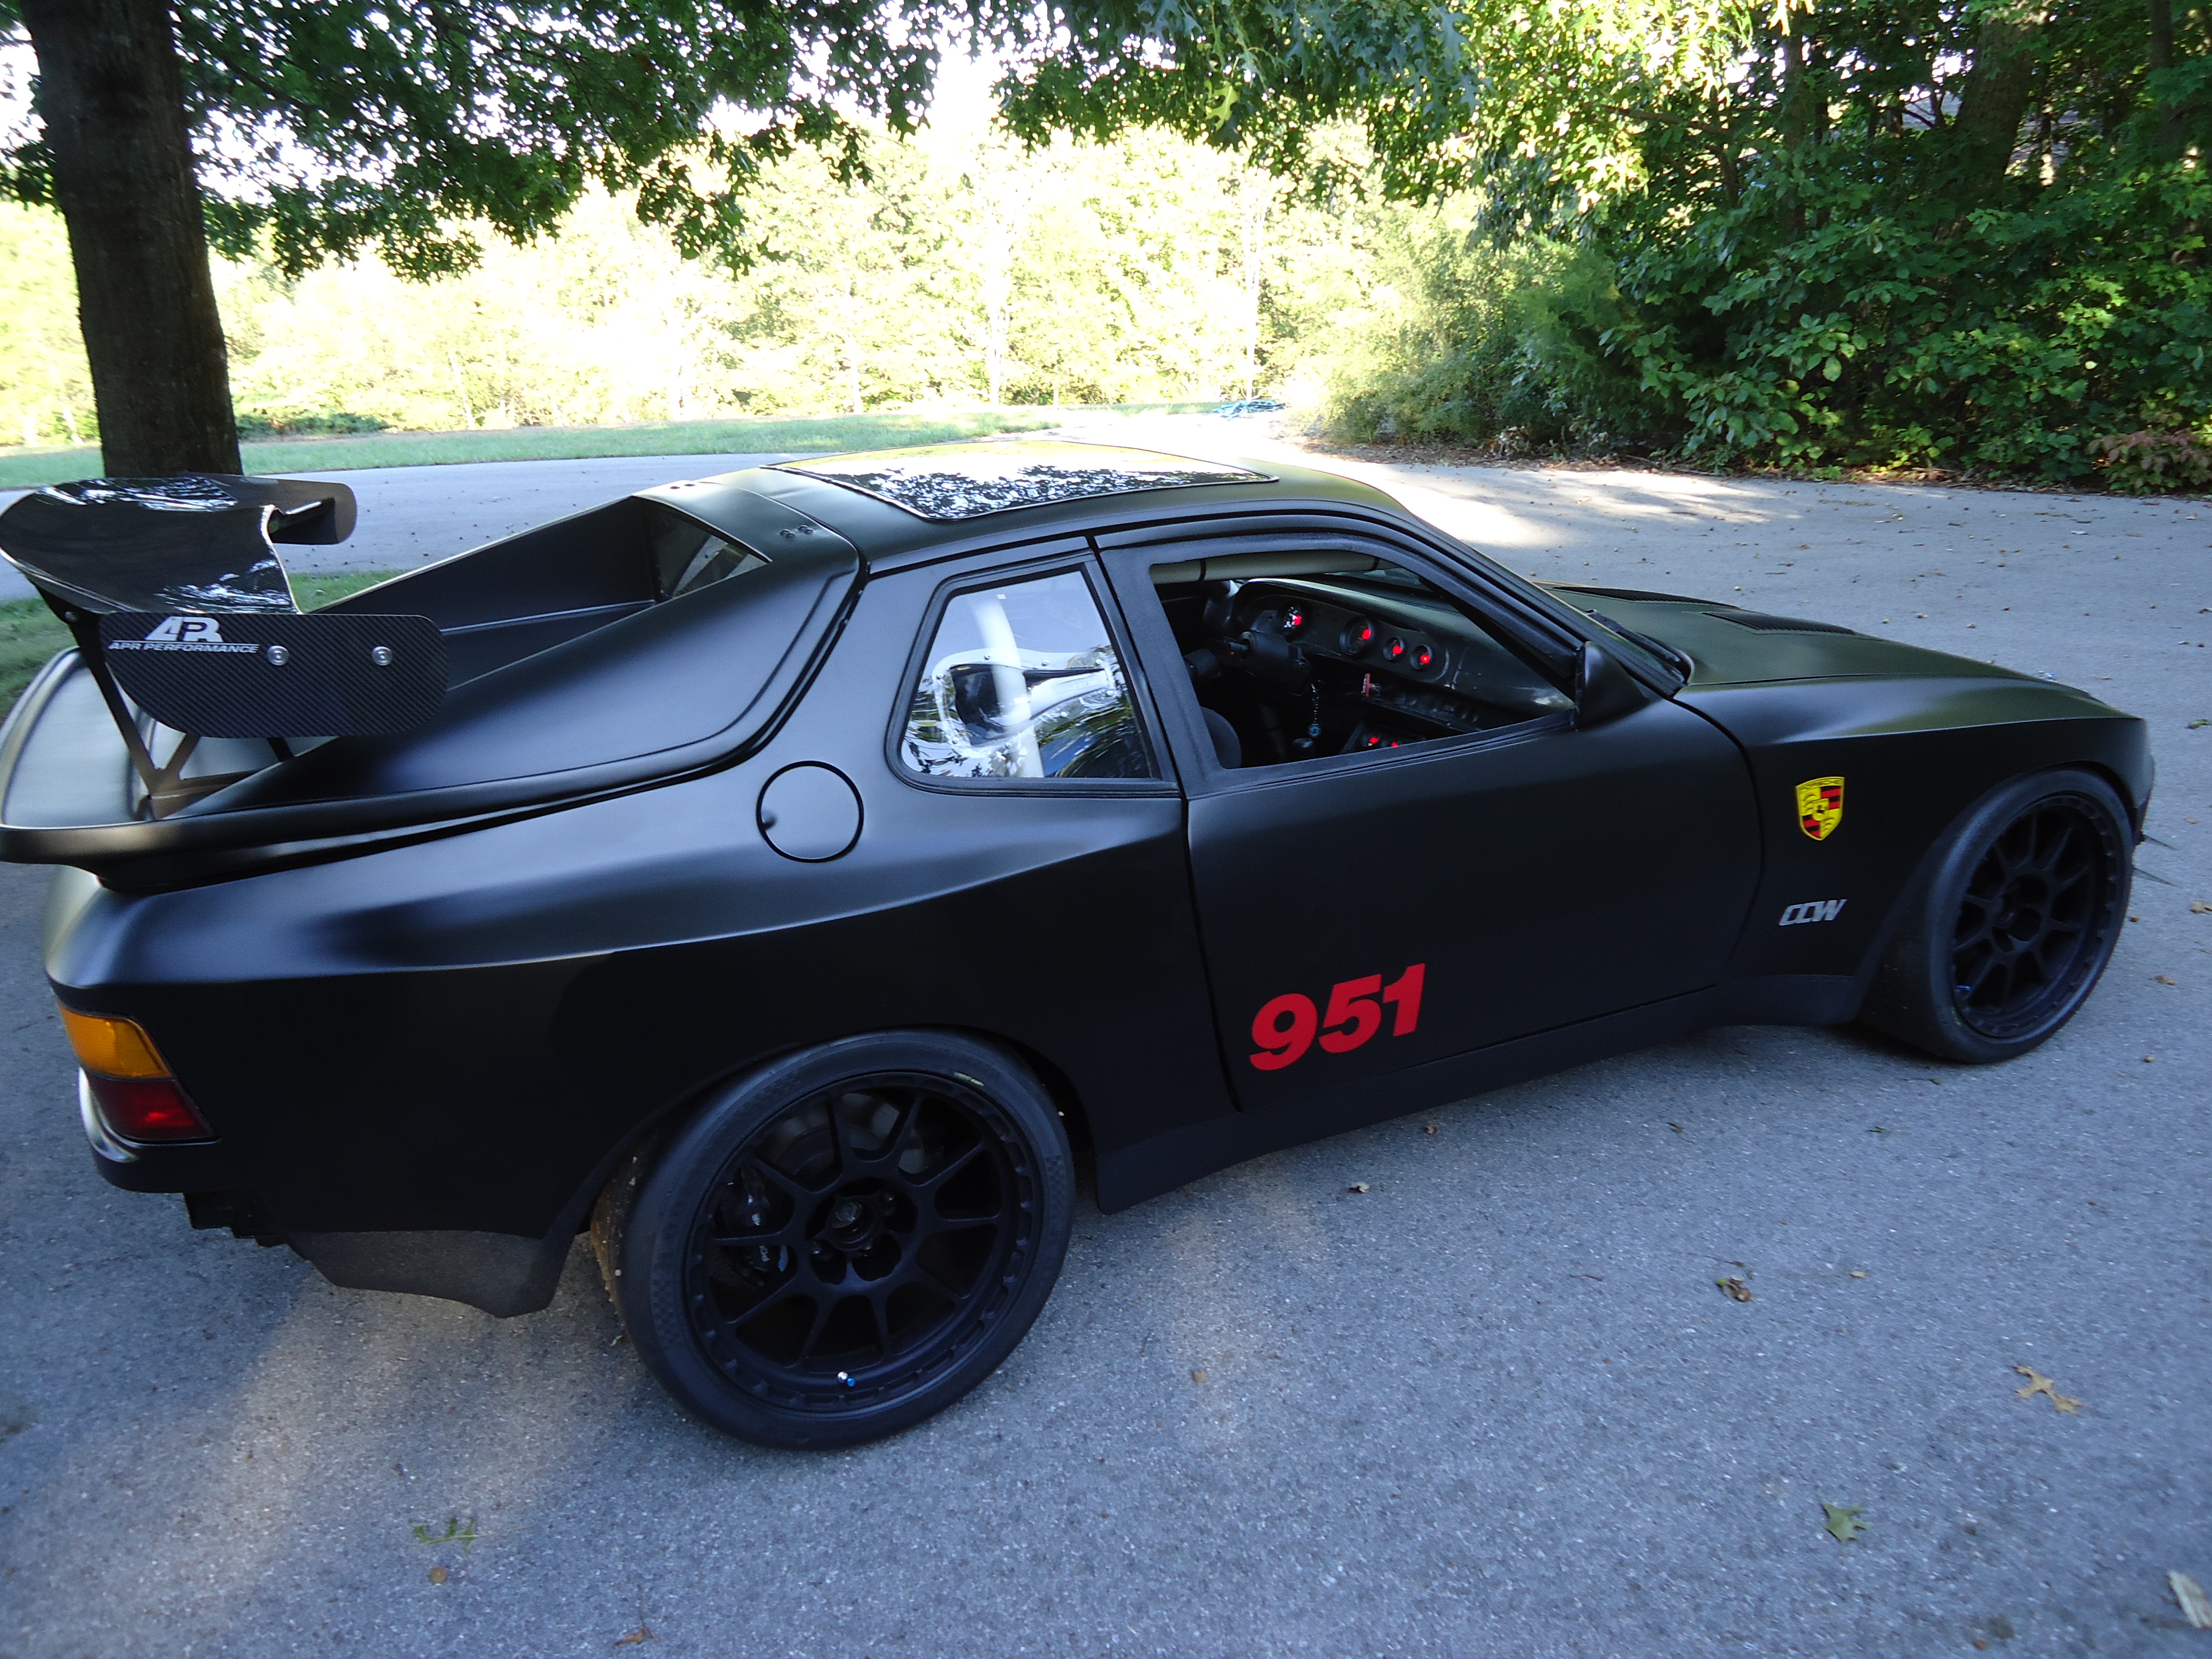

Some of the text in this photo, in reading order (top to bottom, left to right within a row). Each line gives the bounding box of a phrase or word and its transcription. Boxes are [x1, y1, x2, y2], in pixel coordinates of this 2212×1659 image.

[108, 642, 260, 653] APR PERFORMANCE
[1778, 899, 1848, 926] CCW
[1249, 963, 1426, 1071] 951
